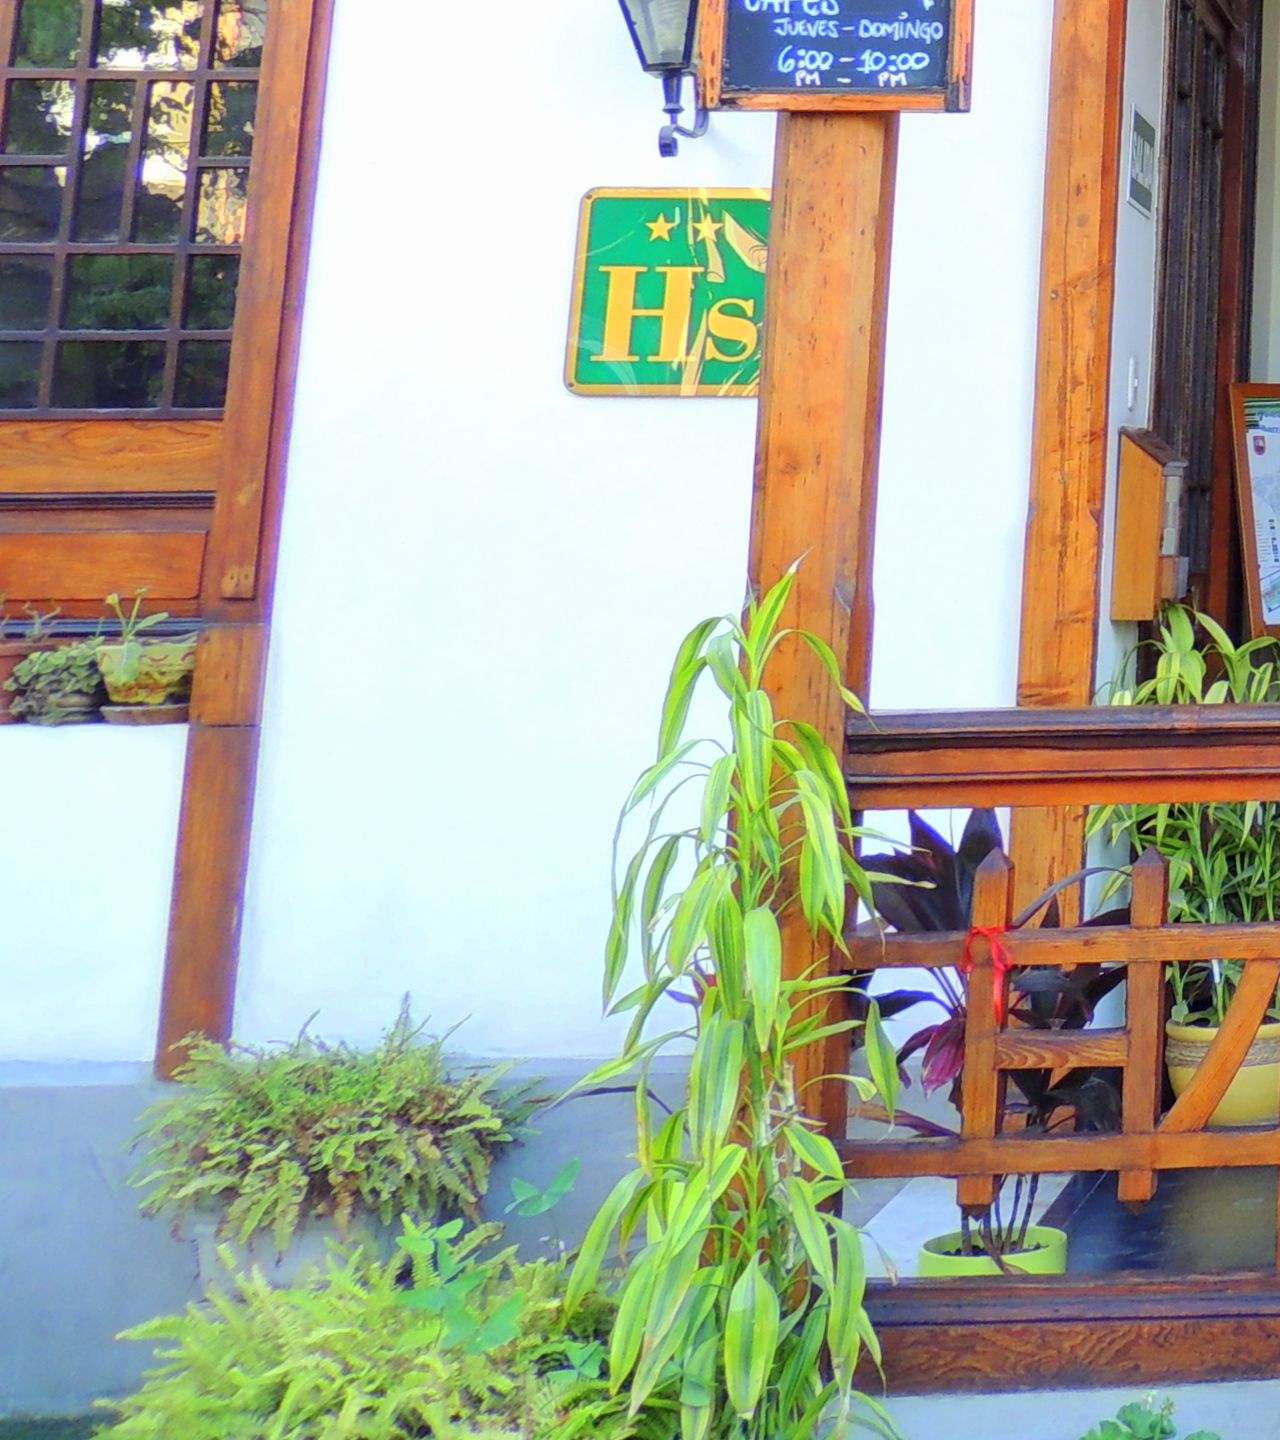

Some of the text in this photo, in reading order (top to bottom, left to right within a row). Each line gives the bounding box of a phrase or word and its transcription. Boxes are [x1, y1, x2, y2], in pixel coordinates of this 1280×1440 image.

[773, 17, 840, 39] JUEVES
[777, 45, 834, 74] 6:00
[856, 48, 930, 74] 10:00
[794, 70, 821, 86] PM
[877, 71, 908, 88] PM
